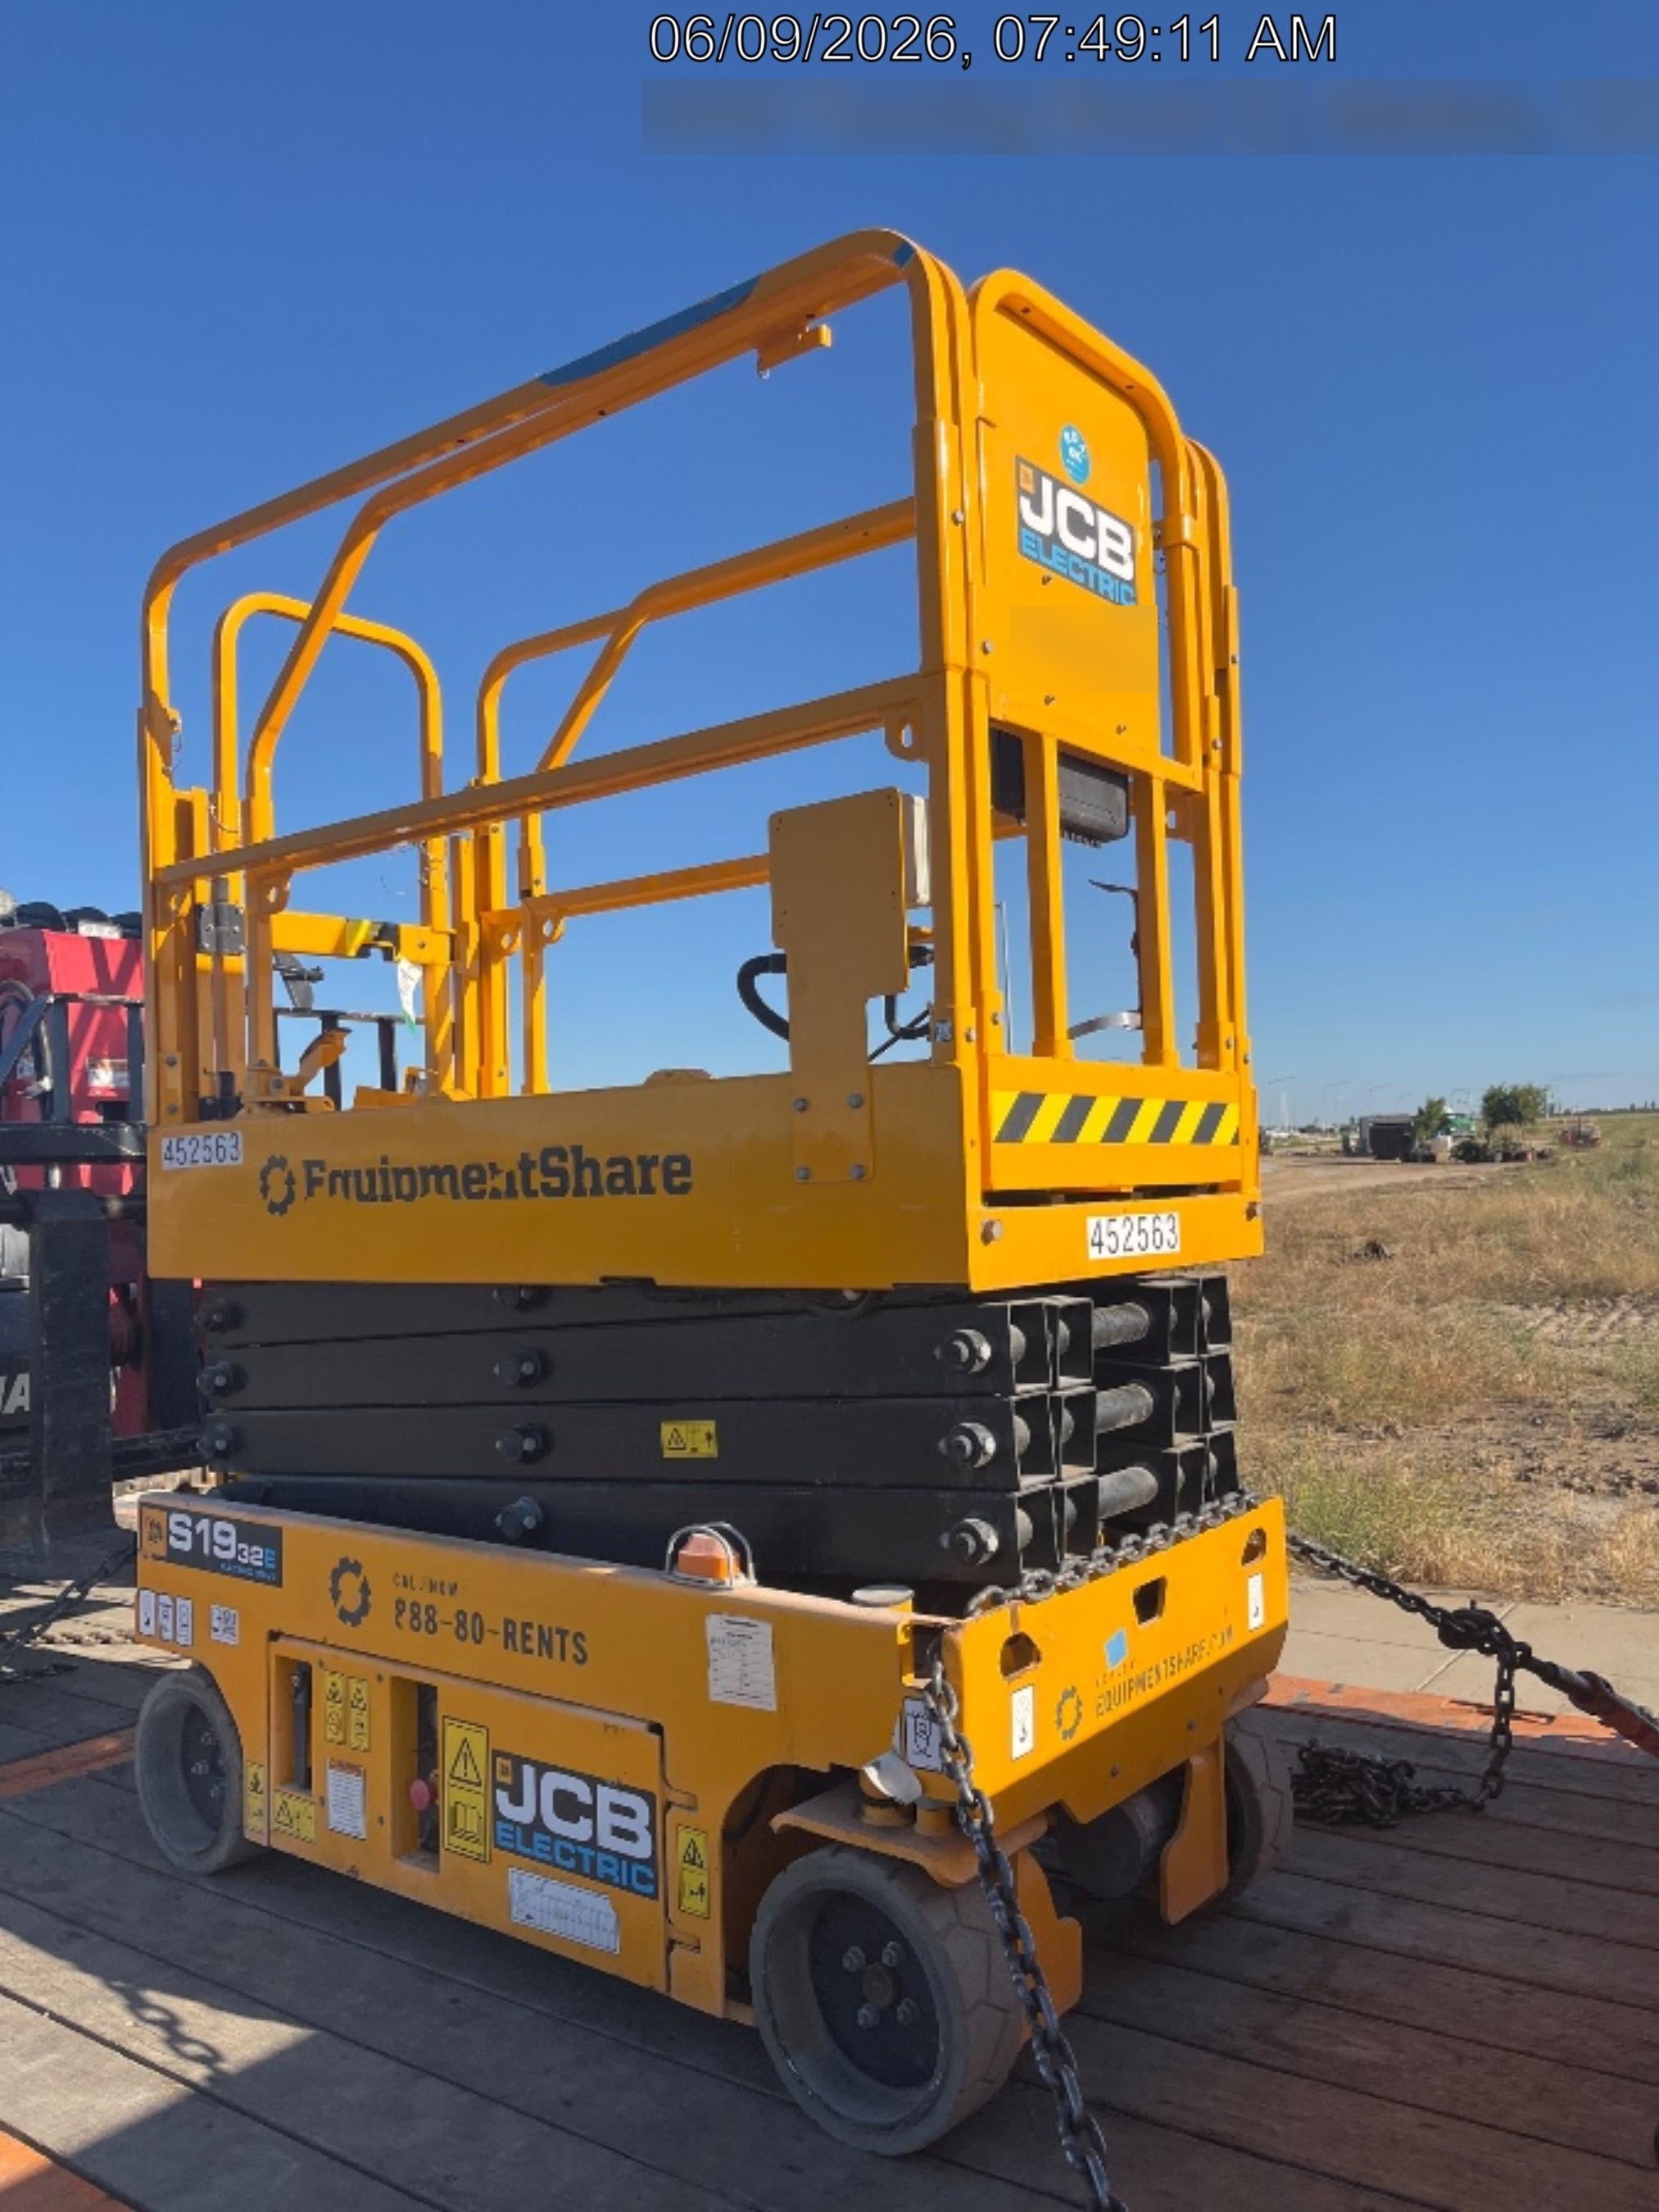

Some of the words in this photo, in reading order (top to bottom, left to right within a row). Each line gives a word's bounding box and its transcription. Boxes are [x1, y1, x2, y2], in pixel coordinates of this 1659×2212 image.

[1019, 475, 1135, 582] JCB
[1021, 527, 1137, 606] ELECTRIC
[164, 1132, 239, 1166] 452563
[1090, 1213, 1179, 1255] 452563
[495, 1763, 654, 1860] JCB
[495, 1820, 656, 1896] ELECTRIC
